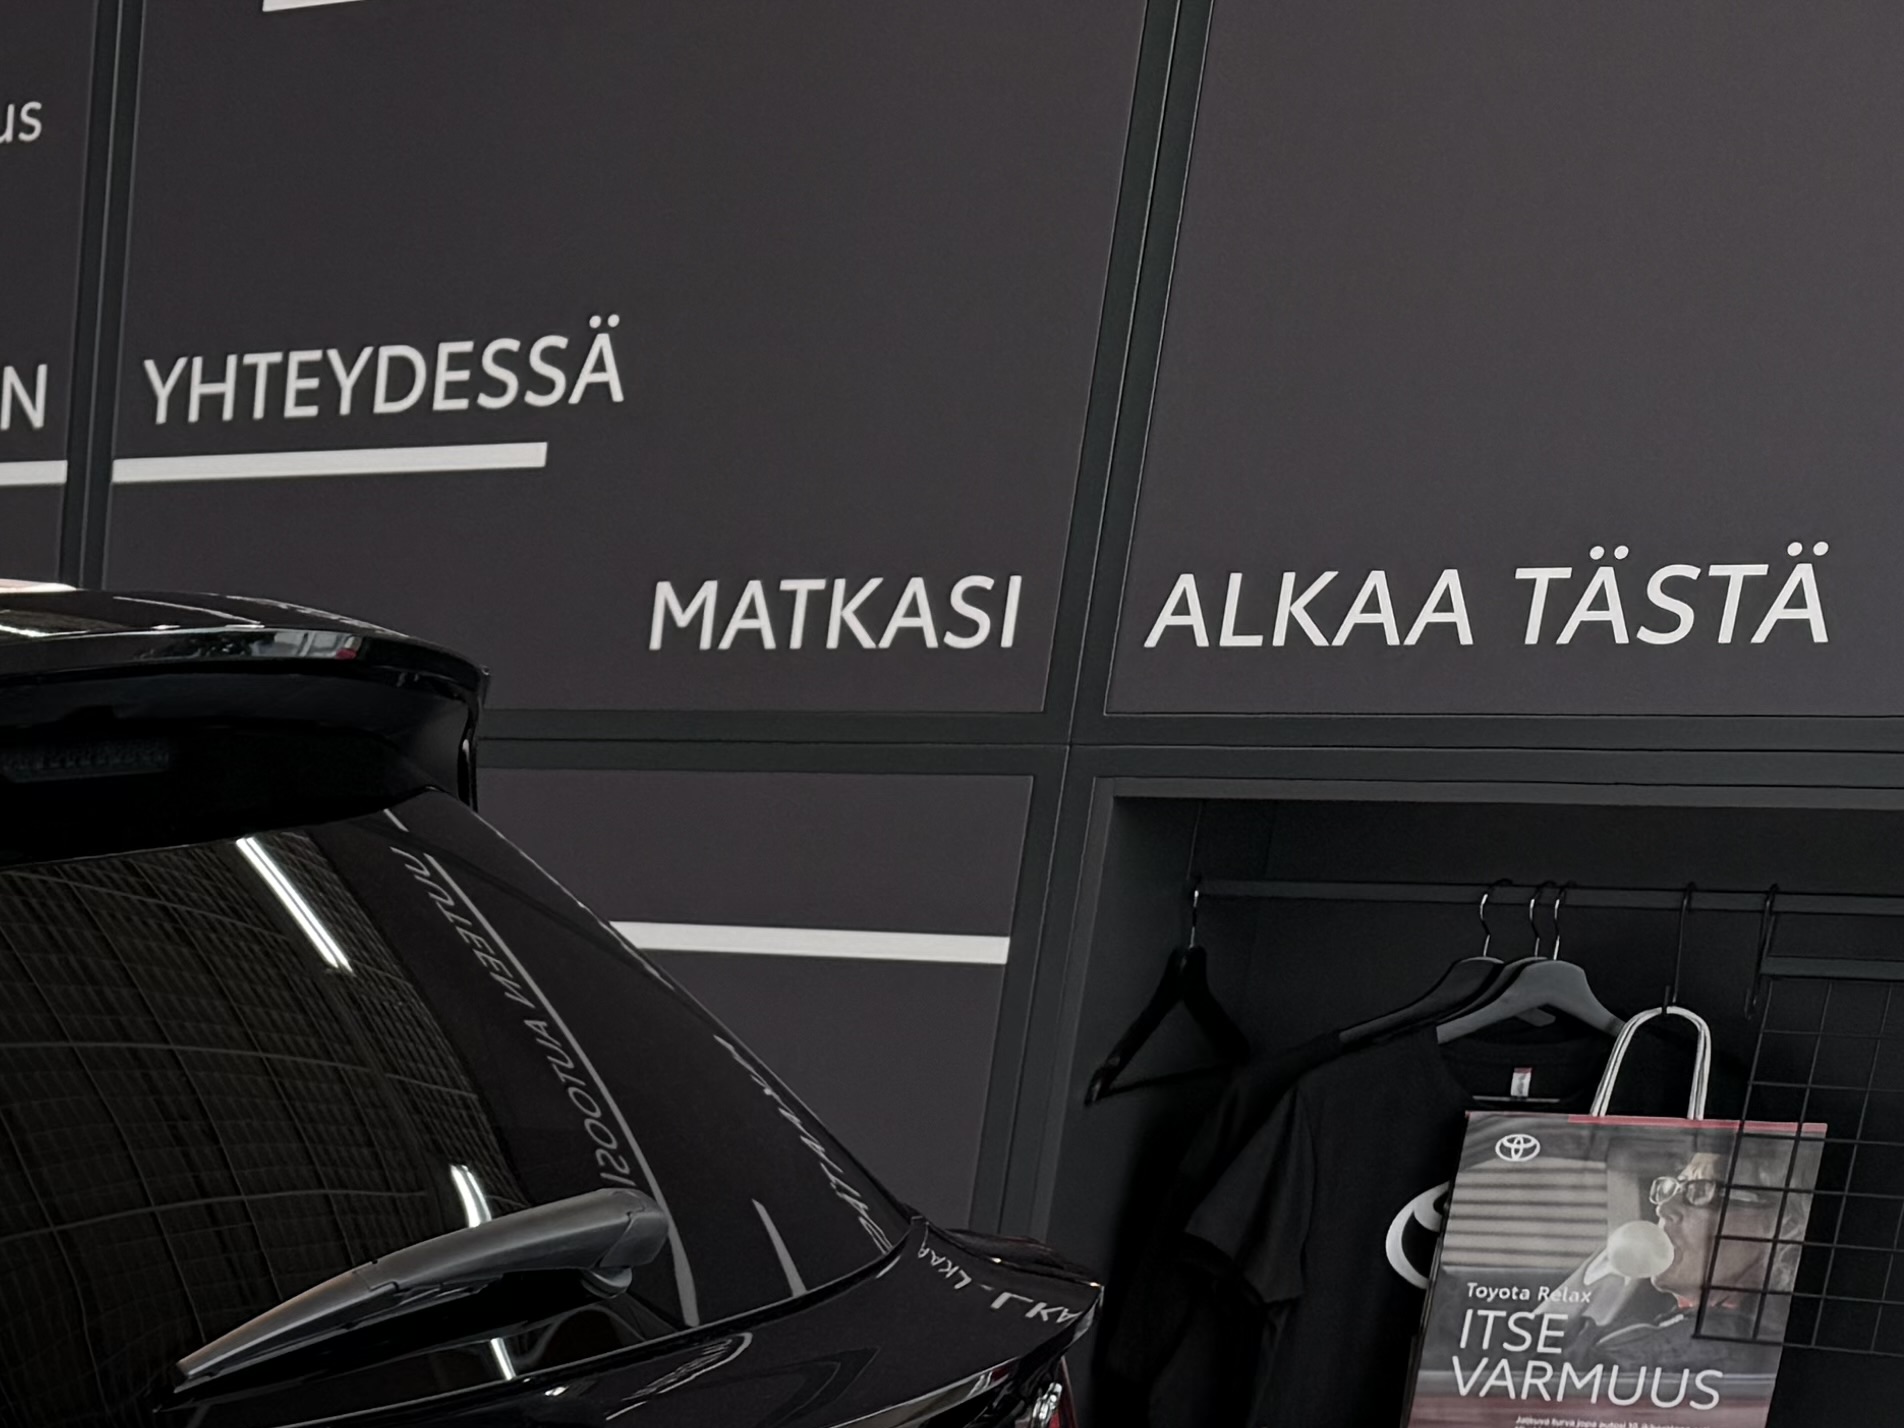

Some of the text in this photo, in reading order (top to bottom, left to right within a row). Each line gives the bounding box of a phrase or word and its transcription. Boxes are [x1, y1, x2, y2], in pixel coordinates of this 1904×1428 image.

[143, 314, 625, 428] YHTEYDESSÄ
[647, 540, 1833, 652] MATKASI ALKAA TÄSTÄ
[1466, 1282, 1593, 1304] Toyota Relax
[1458, 1308, 1570, 1355] ITSE
[1451, 1355, 1724, 1411] VARMUUS
